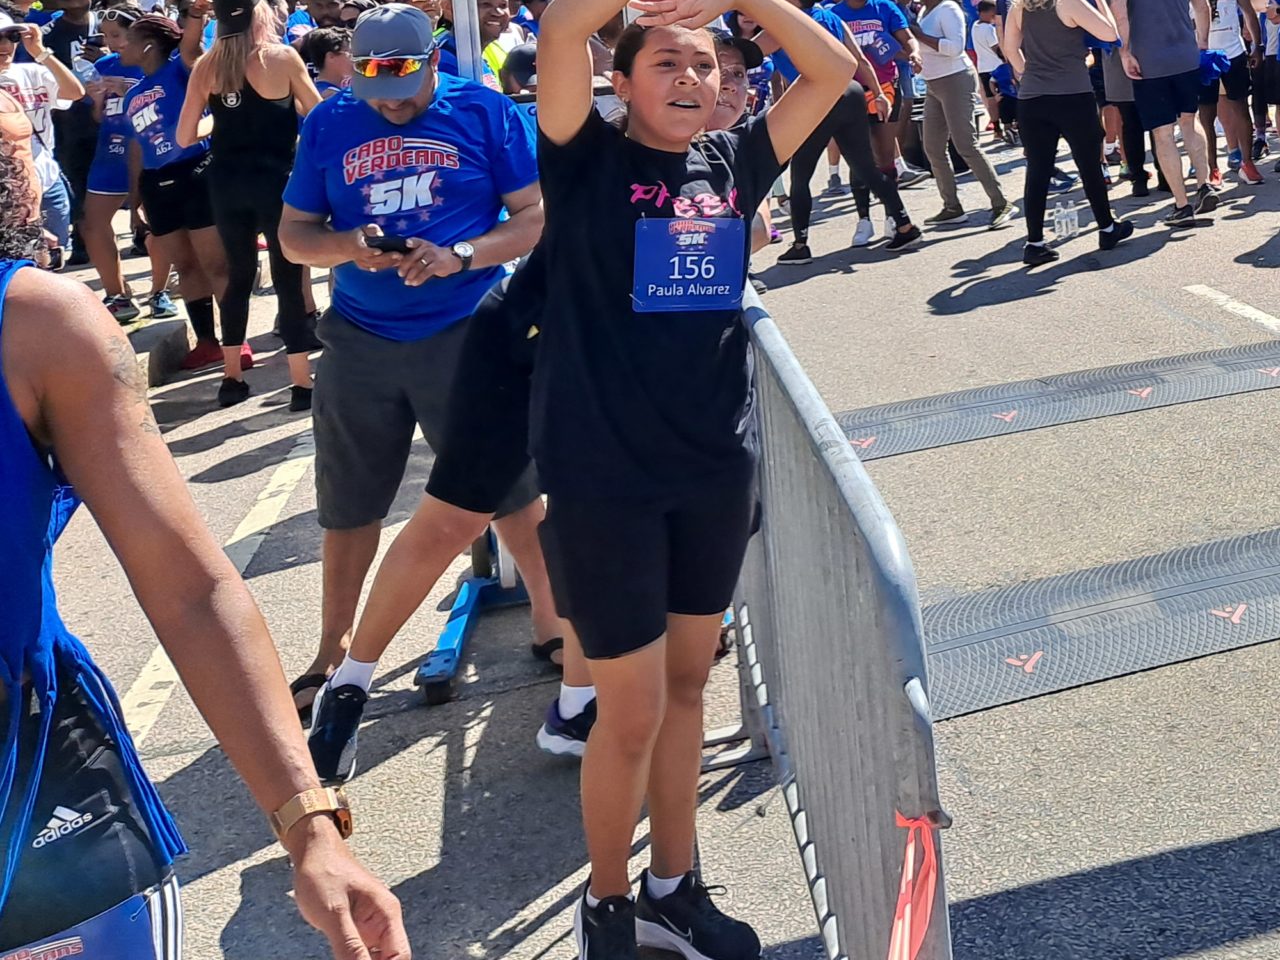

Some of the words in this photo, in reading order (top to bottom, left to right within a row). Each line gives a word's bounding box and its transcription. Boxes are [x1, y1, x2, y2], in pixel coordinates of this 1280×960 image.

[131, 102, 159, 133] 5K
[156, 141, 173, 156] 462
[343, 136, 402, 167] CABO
[343, 149, 459, 185] VERDEANS
[369, 171, 436, 215] 5K
[679, 233, 705, 246] 5K
[669, 256, 715, 279] 156
[647, 283, 684, 297] Paula
[687, 283, 730, 296] Alvarez
[31, 812, 94, 849] adidas
